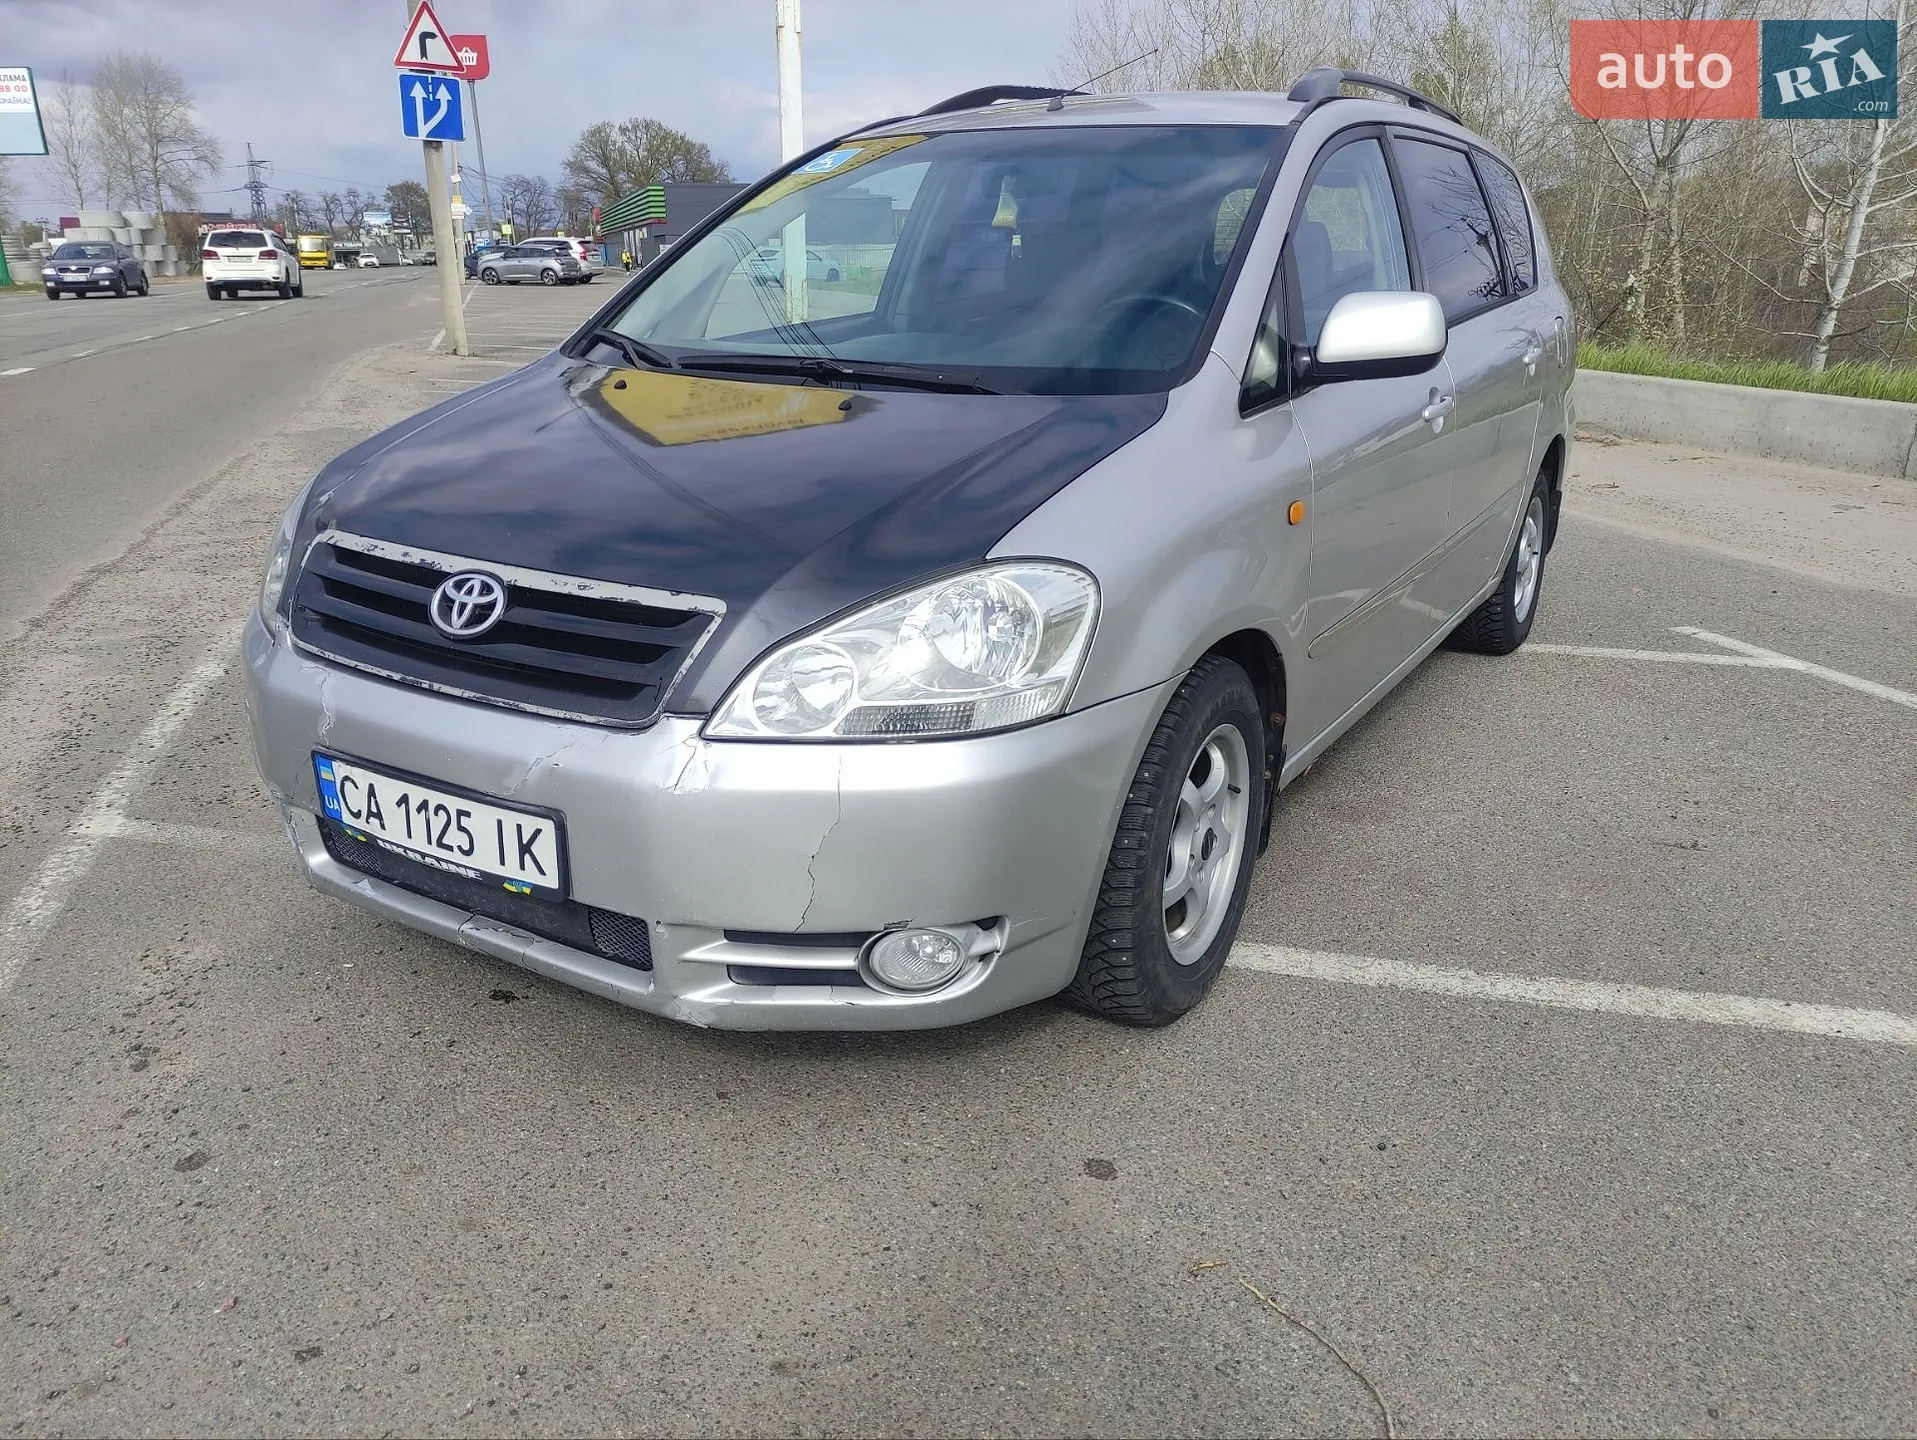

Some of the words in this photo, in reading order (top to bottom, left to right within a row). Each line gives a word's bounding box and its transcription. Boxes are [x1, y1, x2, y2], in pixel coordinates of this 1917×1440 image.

[325, 795, 341, 812] UA
[340, 775, 386, 831] CA
[395, 793, 475, 857] 1125
[496, 818, 547, 877] IK
